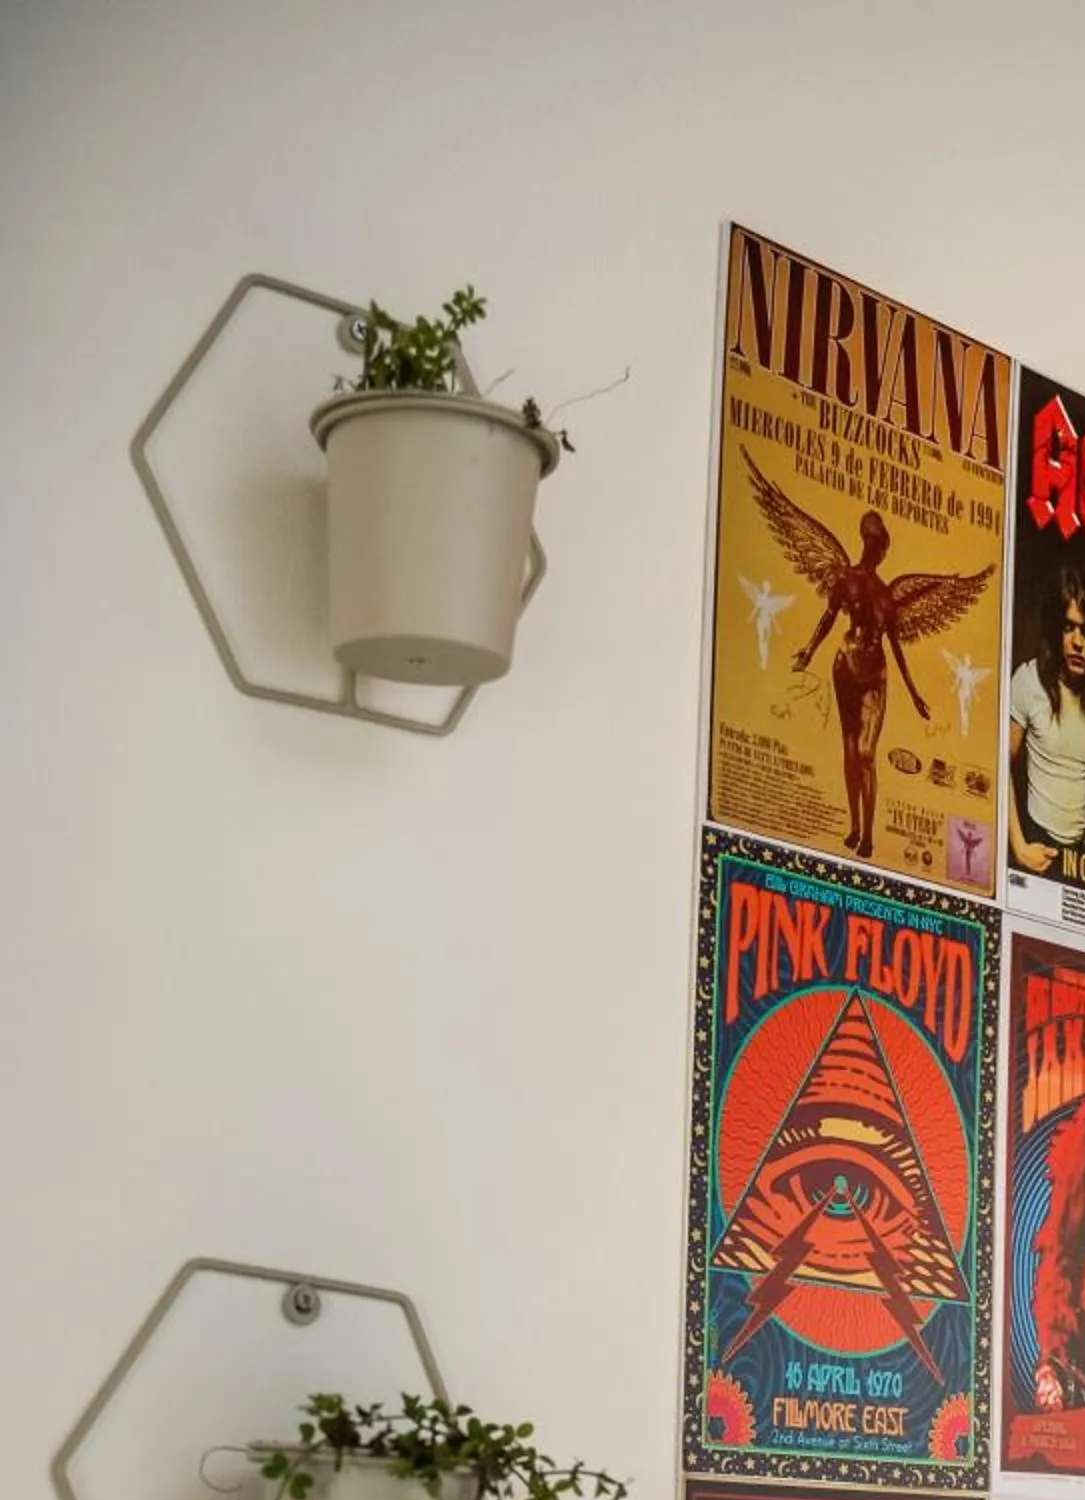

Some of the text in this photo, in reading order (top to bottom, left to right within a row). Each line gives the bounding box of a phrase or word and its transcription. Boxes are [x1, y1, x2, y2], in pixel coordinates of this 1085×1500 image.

[729, 230, 1004, 475] NIRVANA
[819, 400, 921, 470] BUZZCOCKS
[831, 440, 840, 468] 9
[845, 447, 863, 477] de
[869, 456, 943, 511] FEBRERO
[948, 490, 964, 519] de
[892, 496, 950, 535] DEPORTES
[1062, 848, 1078, 878] IN
[725, 881, 830, 1025] PINK
[845, 915, 973, 1065] FLOYD
[807, 1364, 860, 1396] APRIL
[867, 1369, 903, 1398] 1970
[771, 1431, 793, 1445] 2nd
[862, 1405, 909, 1436] EAST
